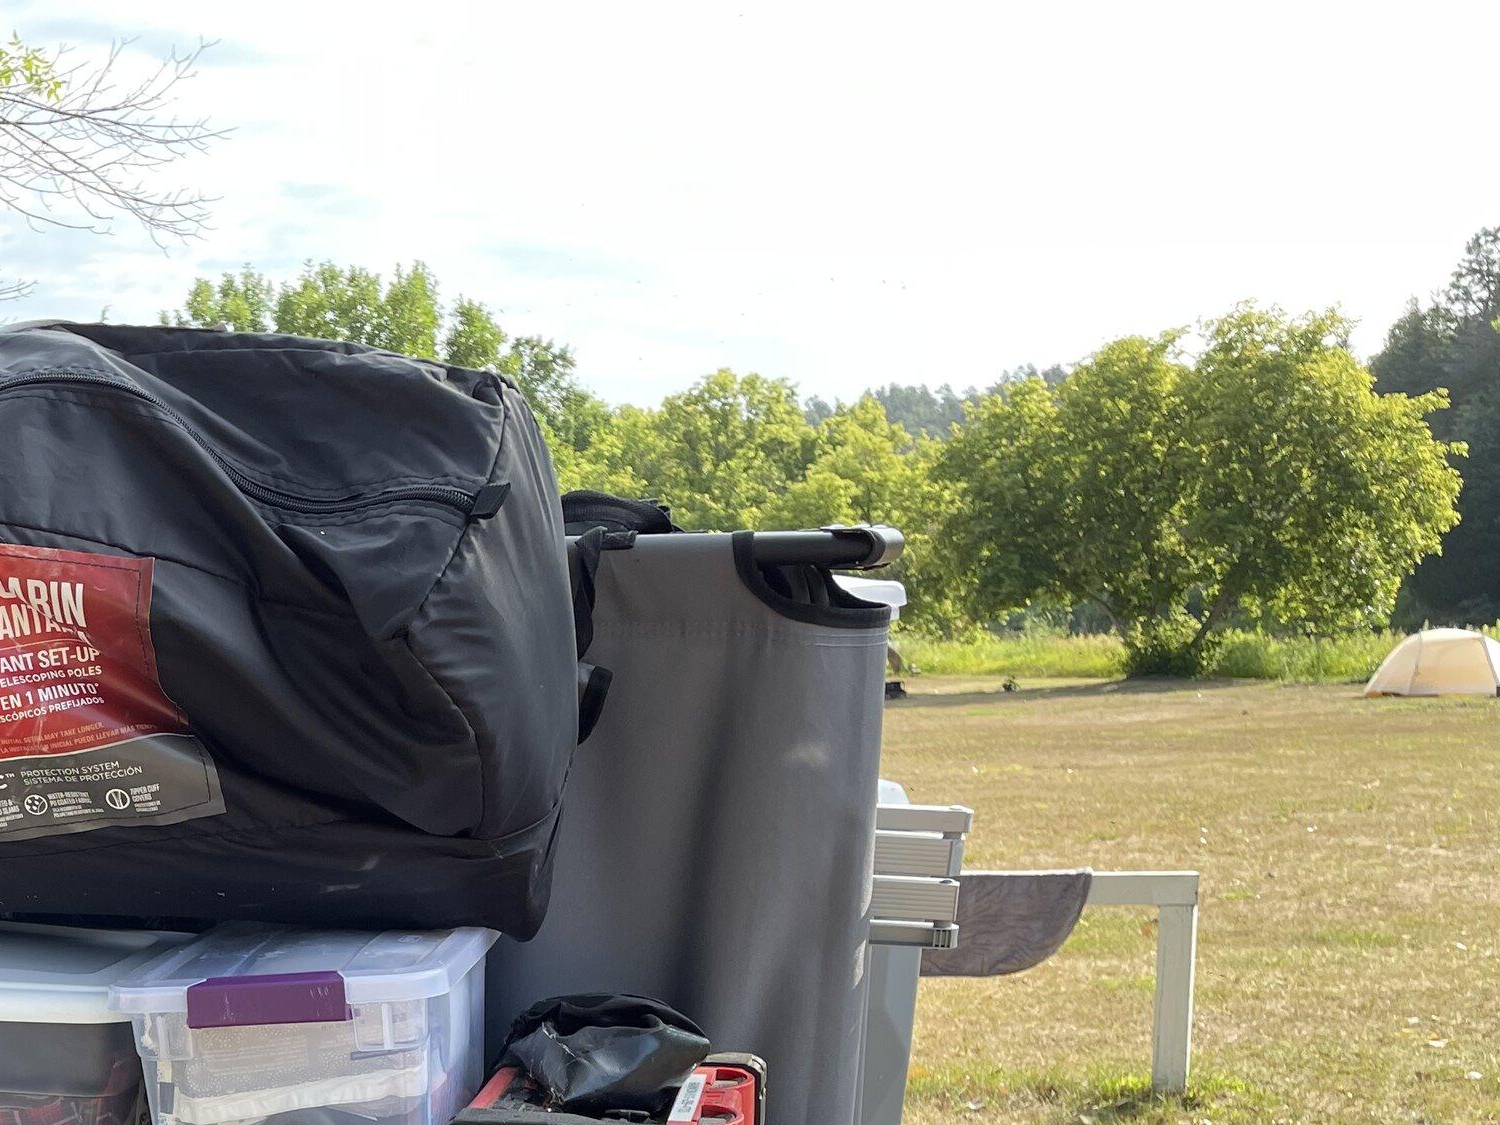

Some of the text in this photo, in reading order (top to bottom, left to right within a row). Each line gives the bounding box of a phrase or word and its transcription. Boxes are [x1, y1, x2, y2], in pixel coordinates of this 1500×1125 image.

[37, 646, 100, 668] SET-UP
[67, 665, 102, 678] POLES
[0, 694, 22, 710] EN
[25, 691, 34, 705] 1
[49, 696, 104, 714] PREFIJADOS
[20, 761, 120, 779] PROTECTION SYSTEM
[23, 775, 63, 786] SISTEMA
[80, 766, 143, 782] PROTECCIÓN
